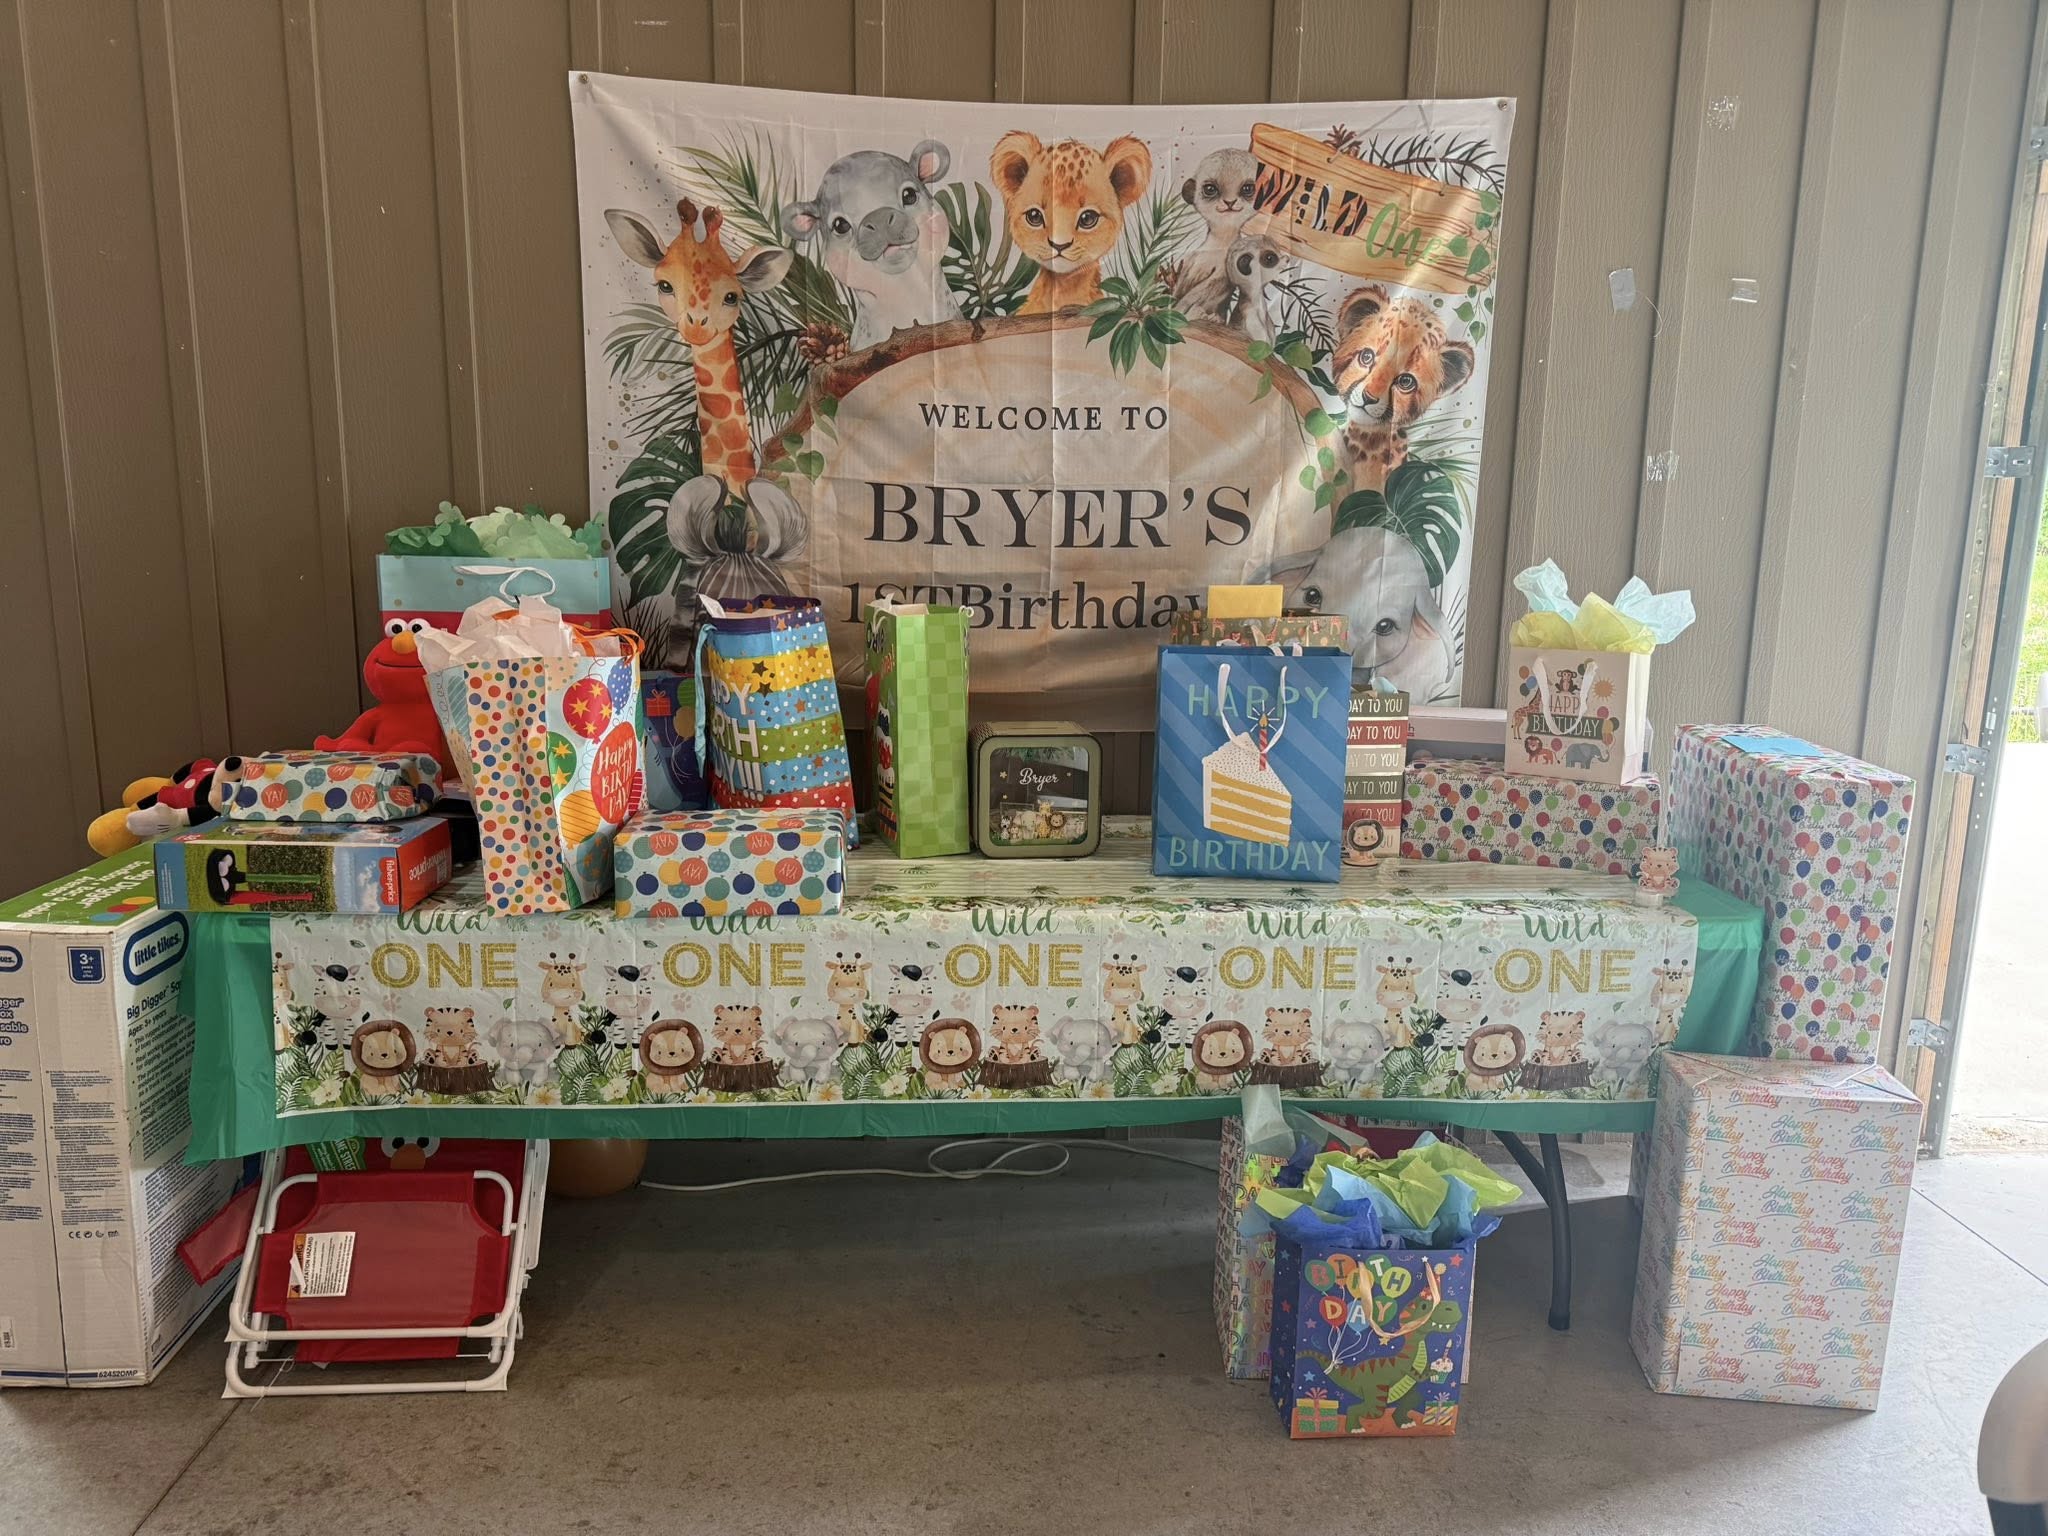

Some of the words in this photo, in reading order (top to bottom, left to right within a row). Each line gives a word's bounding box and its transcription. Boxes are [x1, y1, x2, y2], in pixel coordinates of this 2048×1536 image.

[1253, 162, 1367, 237] WILD
[1365, 202, 1443, 267] One
[919, 403, 1102, 431] WELCOME
[1121, 406, 1168, 430] TO
[864, 482, 1252, 548] BRYER'S
[1188, 684, 1329, 719] HAPPY
[1368, 699, 1381, 713] TO
[1384, 698, 1403, 713] YOU
[1366, 726, 1379, 739] TO
[1382, 725, 1401, 739] YOU
[597, 737, 633, 775] Happy
[1380, 753, 1399, 767] YOU
[602, 760, 633, 798] BIRTH
[1020, 767, 1060, 792] Bryer
[1362, 781, 1375, 794] TO
[1378, 781, 1397, 795] YOU
[266, 788, 283, 802] YAY
[1376, 808, 1395, 822] YOU
[654, 833, 673, 849] YAY
[751, 833, 769, 849] YAY
[1168, 837, 1331, 872] BIRTHDAY
[683, 863, 702, 880] YAY
[780, 863, 797, 879] YAY
[971, 908, 1063, 937] Wild
[1247, 909, 1337, 939] Wild
[1522, 913, 1612, 942] Wild
[79, 953, 94, 965] 3+
[134, 945, 157, 967] little
[157, 933, 180, 954] tikes
[371, 942, 519, 988] ONE
[662, 943, 807, 988] ONE
[944, 943, 1083, 988] ONE
[1219, 945, 1358, 990] ONE
[1494, 948, 1636, 993] ONE
[127, 1005, 140, 1020] Big
[1731, 1090, 1782, 1107] Birthday
[1810, 1098, 1862, 1114] Birthday
[1707, 1111, 1738, 1128] appy
[1771, 1115, 1818, 1133] Happy
[1852, 1120, 1899, 1139] Happy
[1770, 1130, 1824, 1149] Birthday
[1850, 1135, 1904, 1155] Birthday
[1722, 1147, 1768, 1164] Happy
[1801, 1151, 1848, 1169] Happy
[1722, 1161, 1774, 1179] Birthday
[1800, 1165, 1853, 1184] Birthday
[1700, 1181, 1729, 1198] appy
[1762, 1185, 1808, 1202] Happy
[1841, 1191, 1888, 1209] Happy
[1761, 1201, 1814, 1219] Birthday
[1840, 1205, 1894, 1225] Birthday
[1714, 1215, 1759, 1232] Happy
[1792, 1220, 1838, 1238] Happy
[1713, 1230, 1765, 1247] Birthday
[1791, 1236, 1844, 1253] Birthday
[1690, 1249, 1721, 1266] appy
[1753, 1253, 1799, 1272] Happy
[1832, 1259, 1879, 1277] Happy
[1752, 1269, 1805, 1286] Birthday
[1831, 1274, 1884, 1293] Birthday
[1706, 1283, 1751, 1300] Happy
[1783, 1288, 1828, 1306] Happy
[1325, 1300, 1393, 1325] DAY
[1704, 1298, 1756, 1315] Birthday
[1782, 1304, 1834, 1321] Birthday
[1680, 1316, 1713, 1333] appy
[1745, 1322, 1790, 1341] Happy
[1822, 1327, 1869, 1345] Happy
[1744, 1337, 1796, 1356] Birthday
[1822, 1343, 1873, 1361] Birthday
[1699, 1352, 1743, 1369] Happy
[1775, 1357, 1820, 1375] Happy
[1697, 1367, 1749, 1383] Birthday
[1774, 1373, 1825, 1388] Birthday
